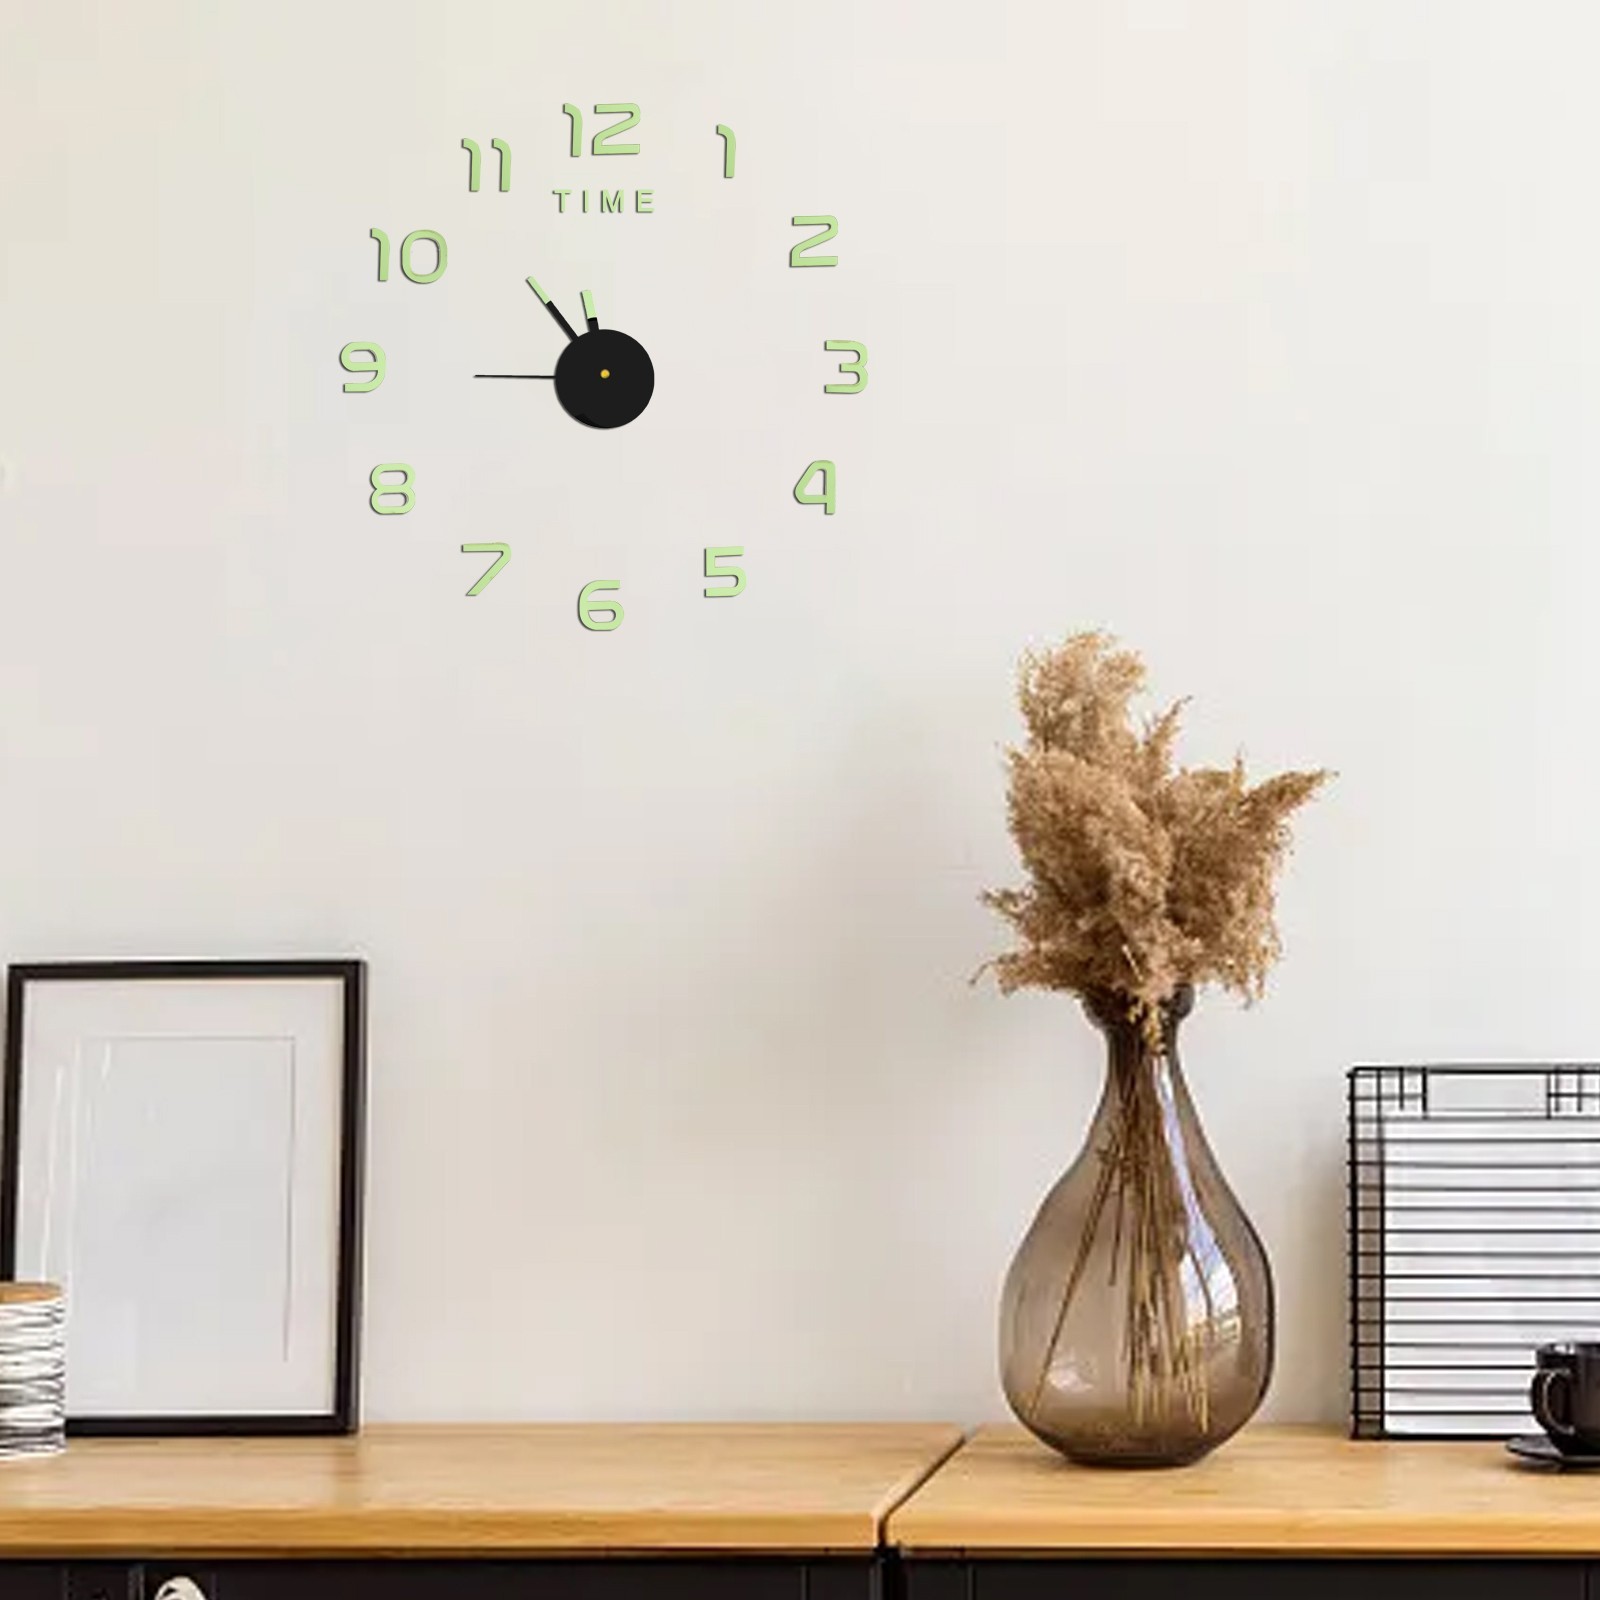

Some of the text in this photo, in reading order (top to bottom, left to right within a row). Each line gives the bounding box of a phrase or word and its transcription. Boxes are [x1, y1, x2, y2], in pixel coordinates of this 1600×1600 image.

[563, 103, 641, 157] 12
[716, 124, 736, 178] 1
[461, 138, 511, 192] 11
[552, 189, 655, 213] TIME
[370, 227, 448, 284] 10
[789, 215, 839, 267] 2
[339, 342, 387, 393] 9
[824, 340, 869, 394] 3
[369, 463, 416, 515] 8
[793, 460, 836, 515] 4
[461, 542, 512, 596] 7
[704, 546, 747, 597] 5
[577, 579, 625, 631] 6
